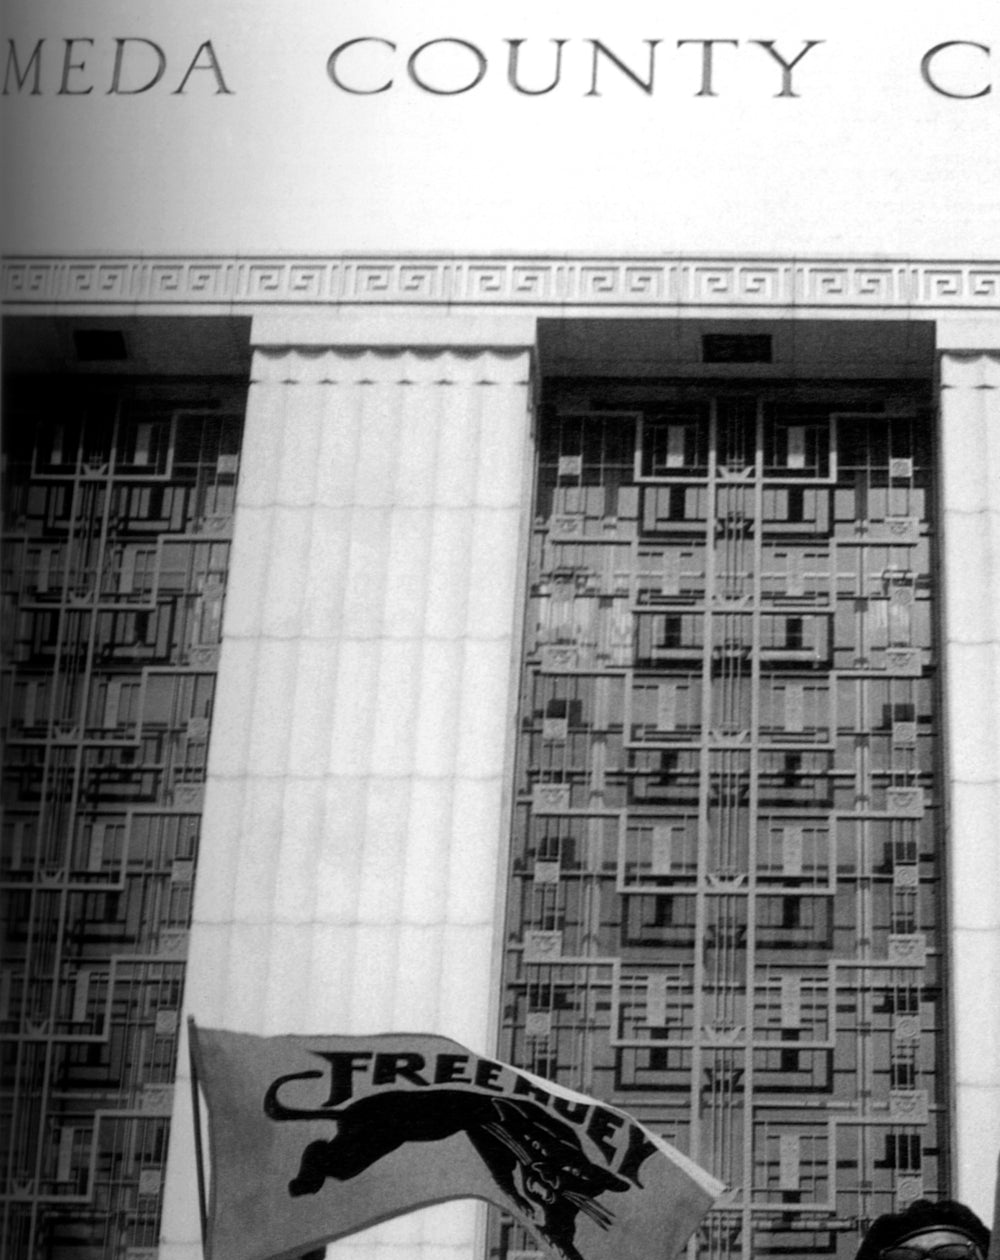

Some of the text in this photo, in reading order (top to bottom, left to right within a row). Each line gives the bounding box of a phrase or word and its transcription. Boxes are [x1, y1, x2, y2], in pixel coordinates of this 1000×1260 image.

[1, 37, 236, 96] MEDA
[325, 36, 825, 98] COUNTY
[308, 1050, 506, 1108] FREE
